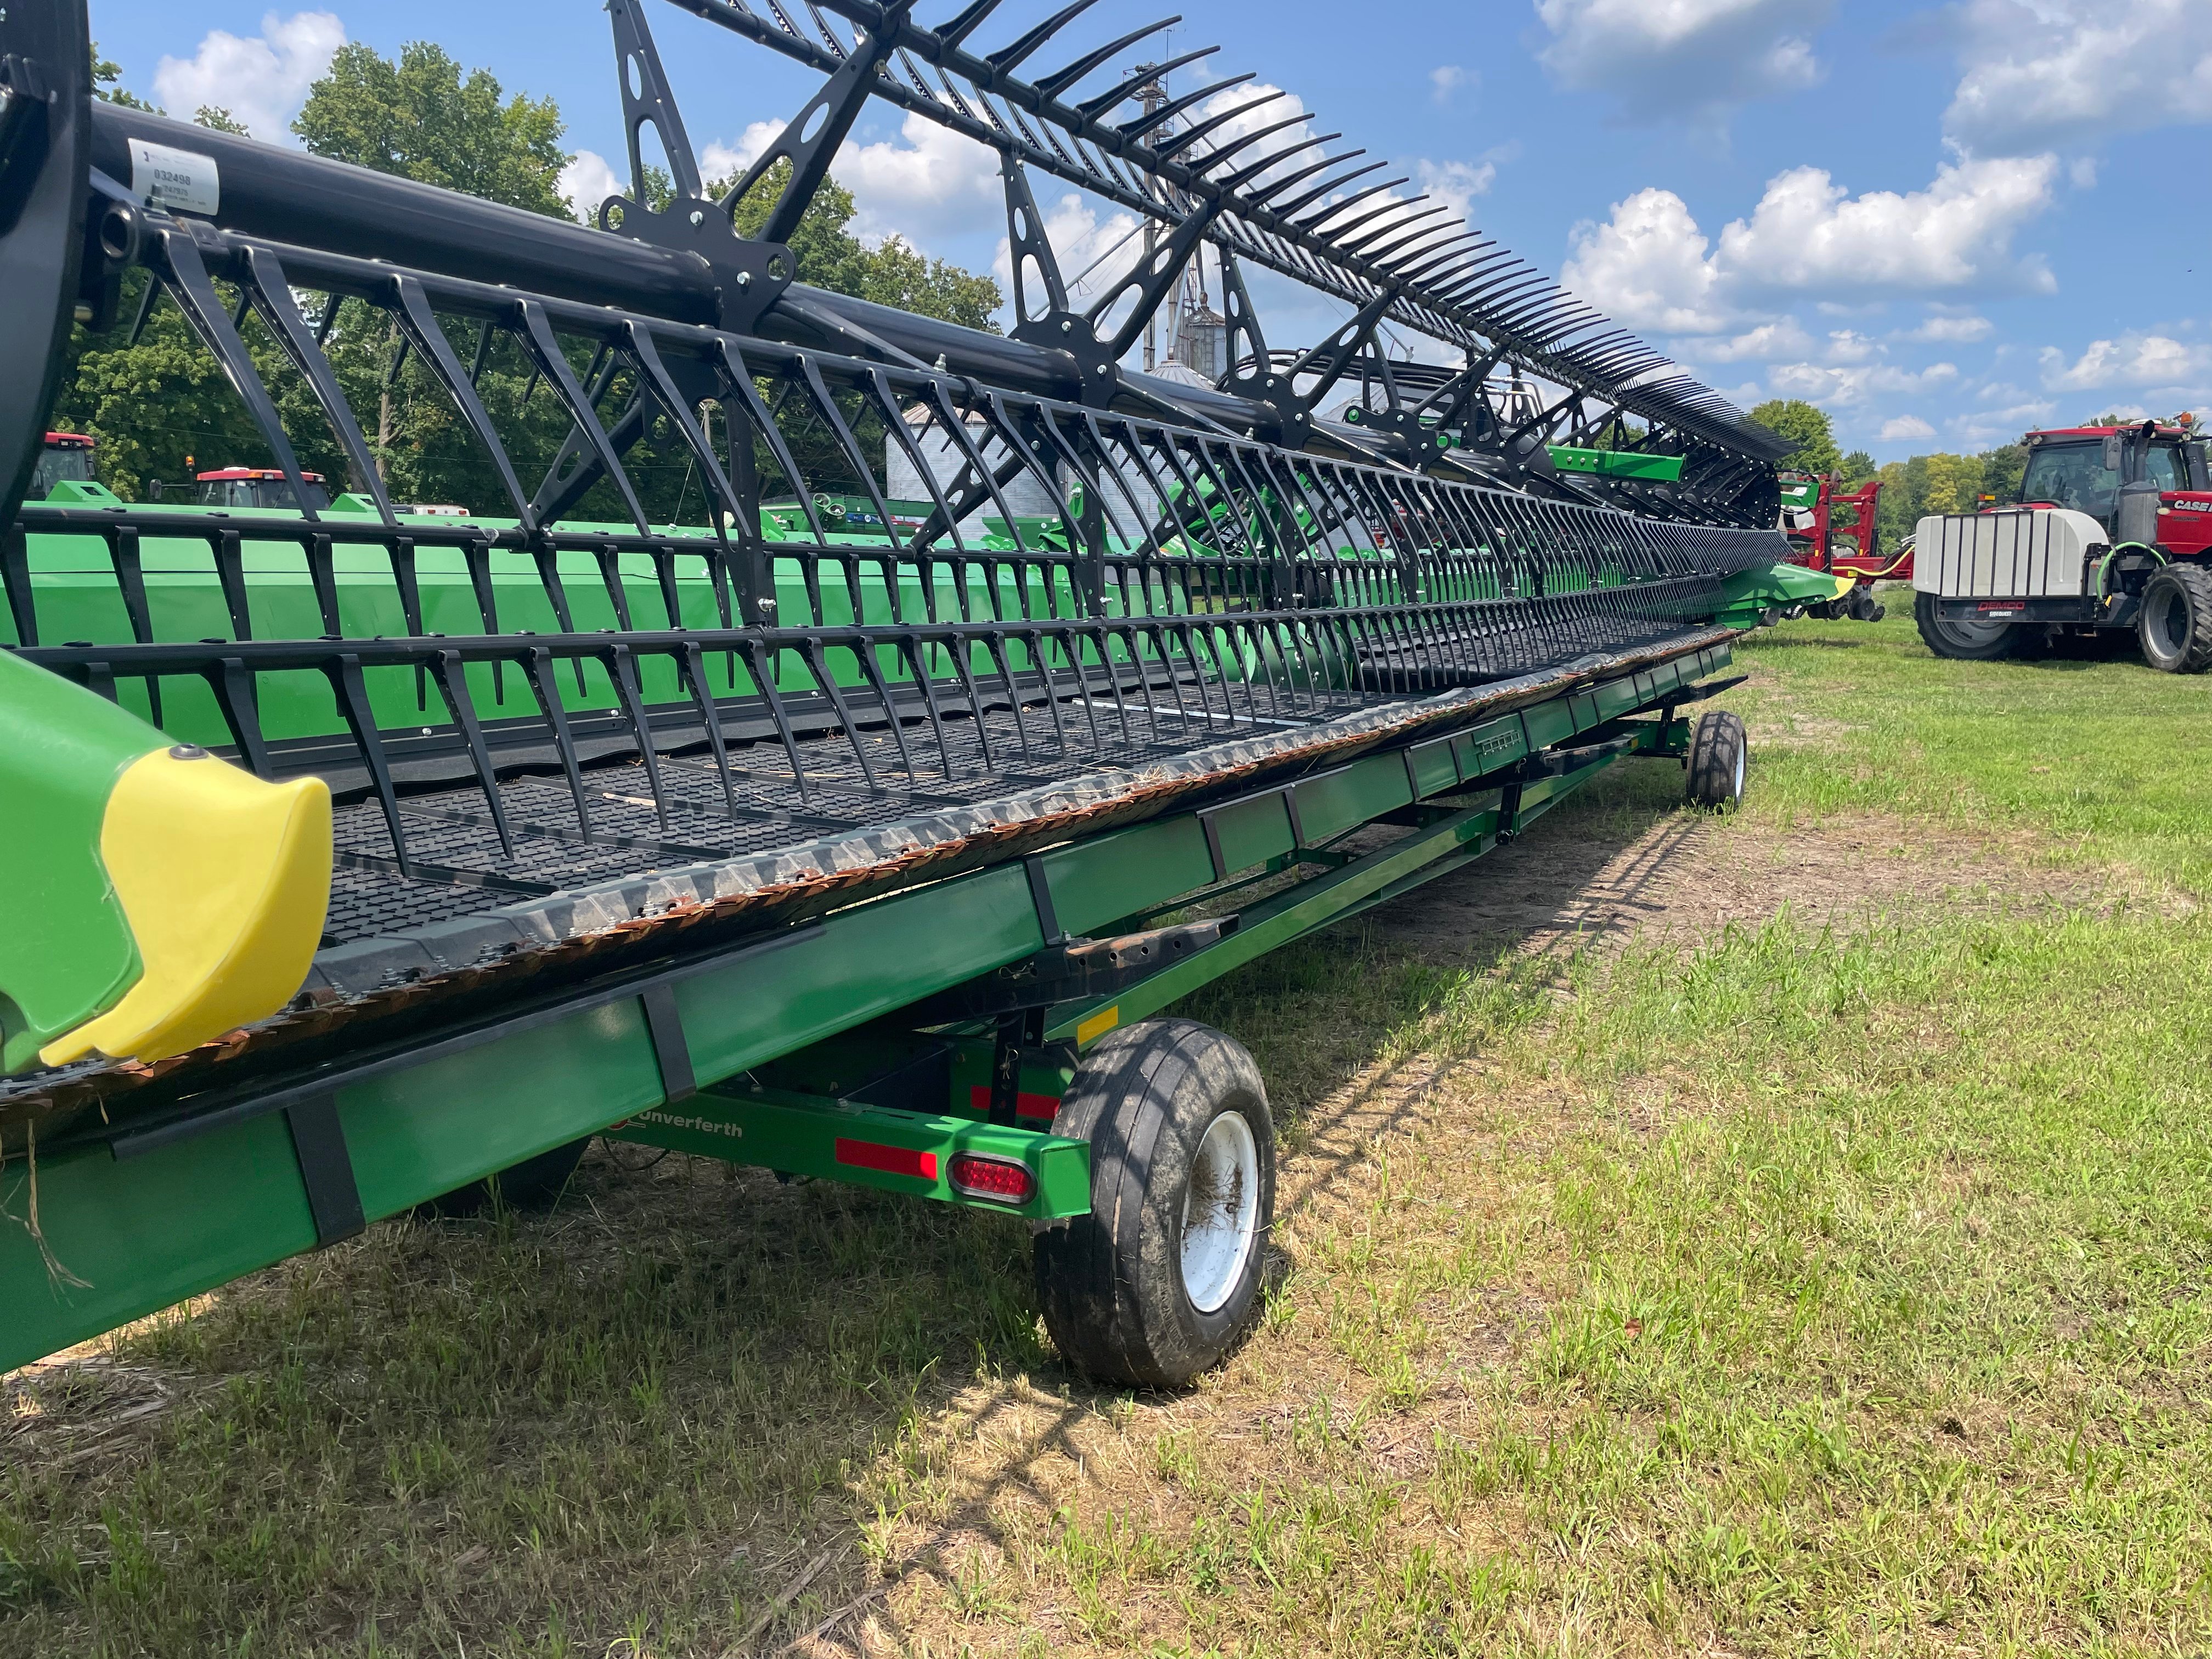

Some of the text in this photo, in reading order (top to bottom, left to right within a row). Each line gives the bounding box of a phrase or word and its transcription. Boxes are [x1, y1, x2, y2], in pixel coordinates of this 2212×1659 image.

[154, 168, 191, 186] 032498
[2174, 499, 2209, 511] CASE
[1977, 601, 2025, 612] DEMCO
